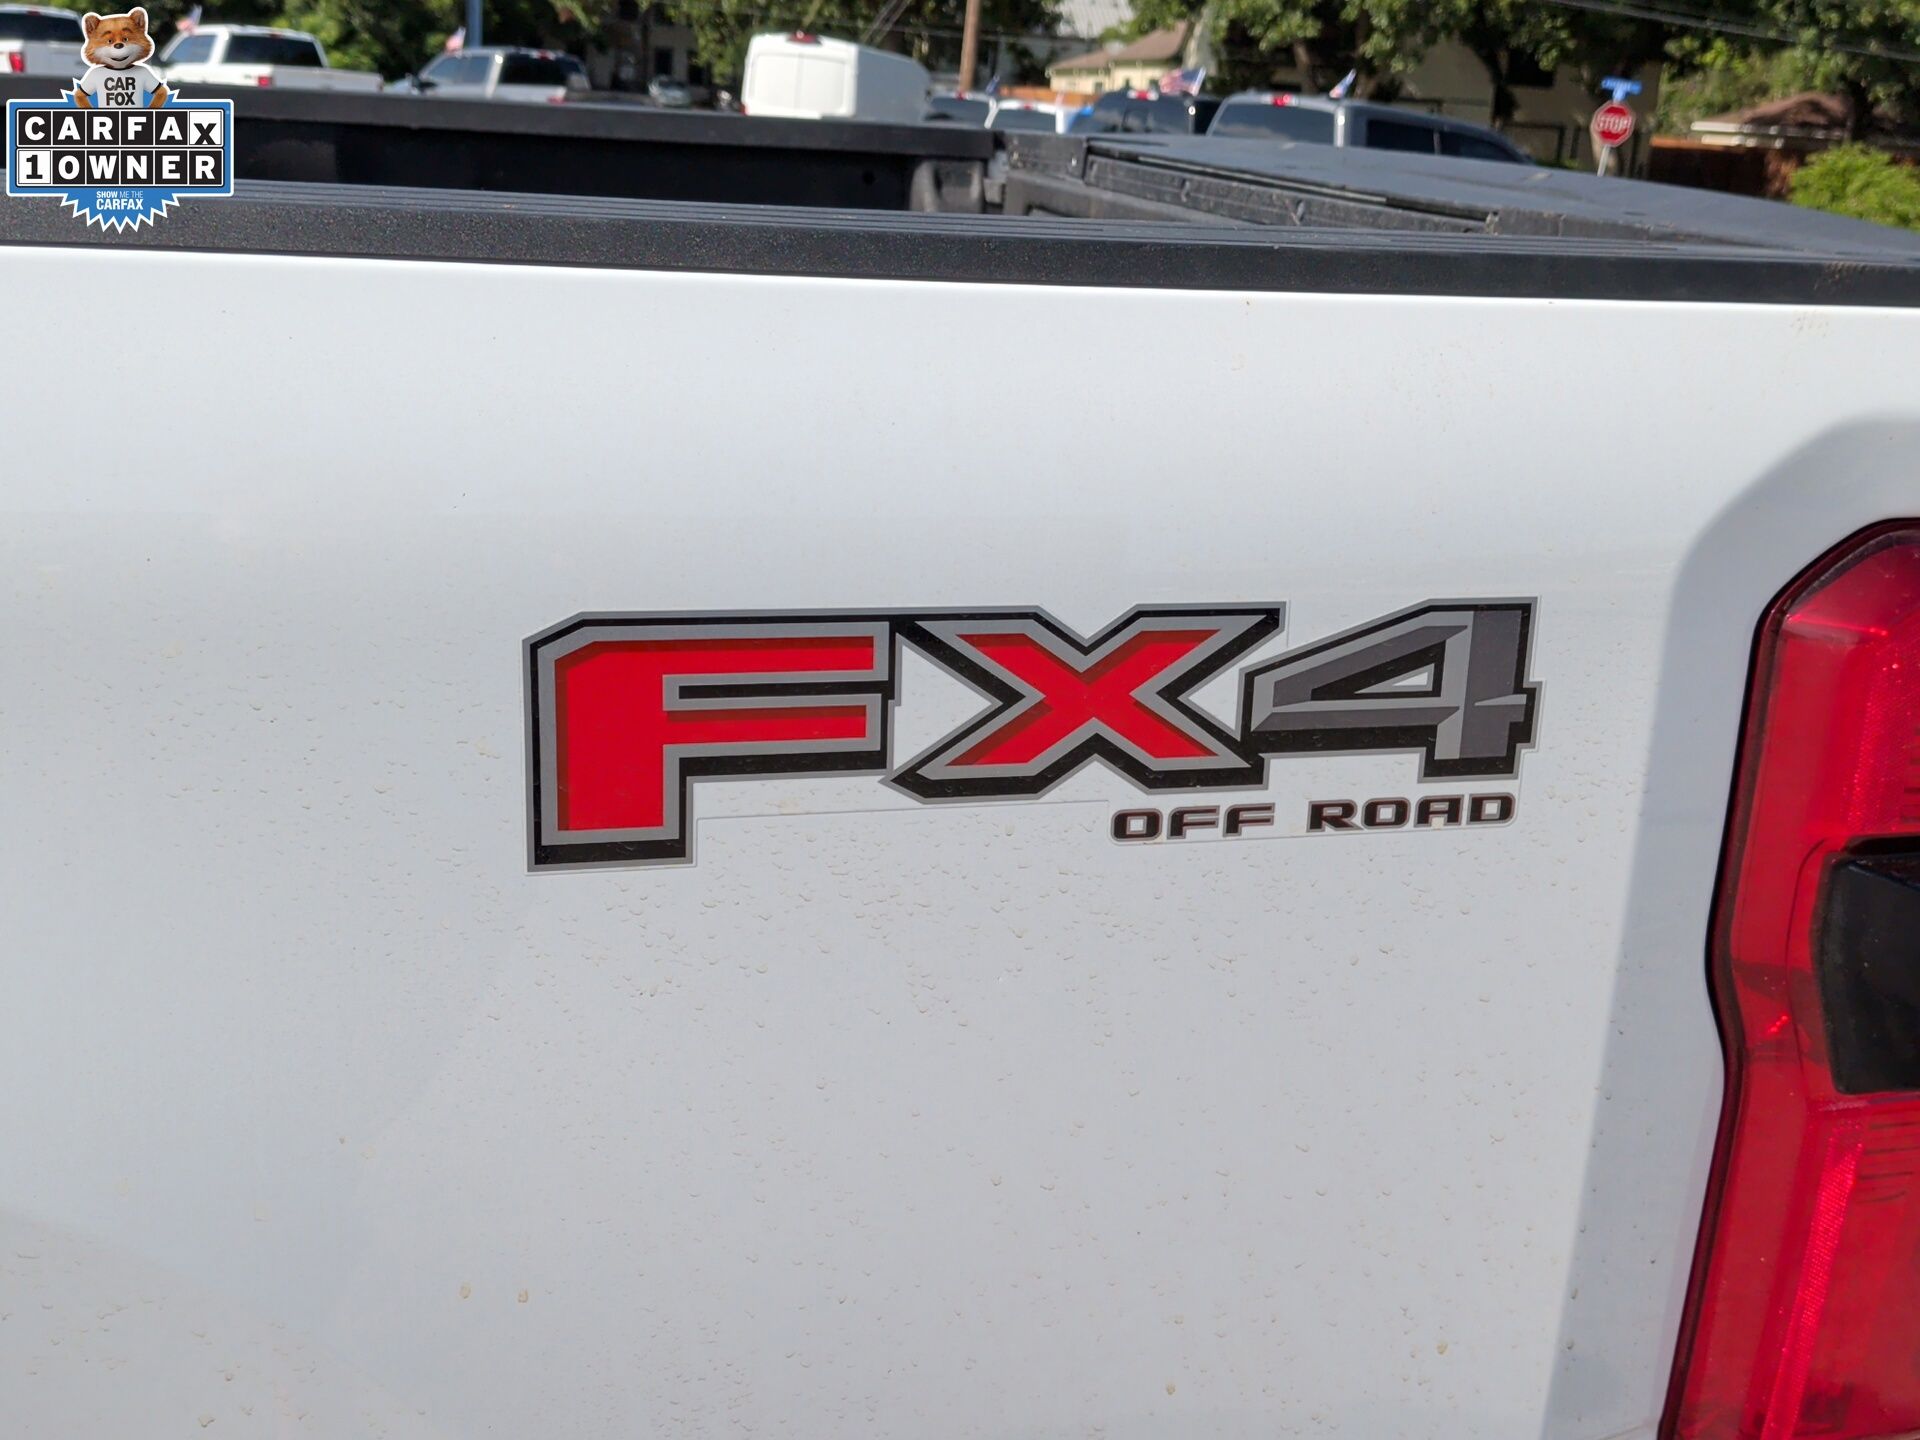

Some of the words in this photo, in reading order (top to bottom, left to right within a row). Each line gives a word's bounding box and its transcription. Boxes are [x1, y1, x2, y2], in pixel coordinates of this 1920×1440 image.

[1597, 114, 1632, 133] STOP
[524, 598, 1537, 872] FX4
[1111, 803, 1275, 841] OFF
[1306, 792, 1518, 833] ROAD
